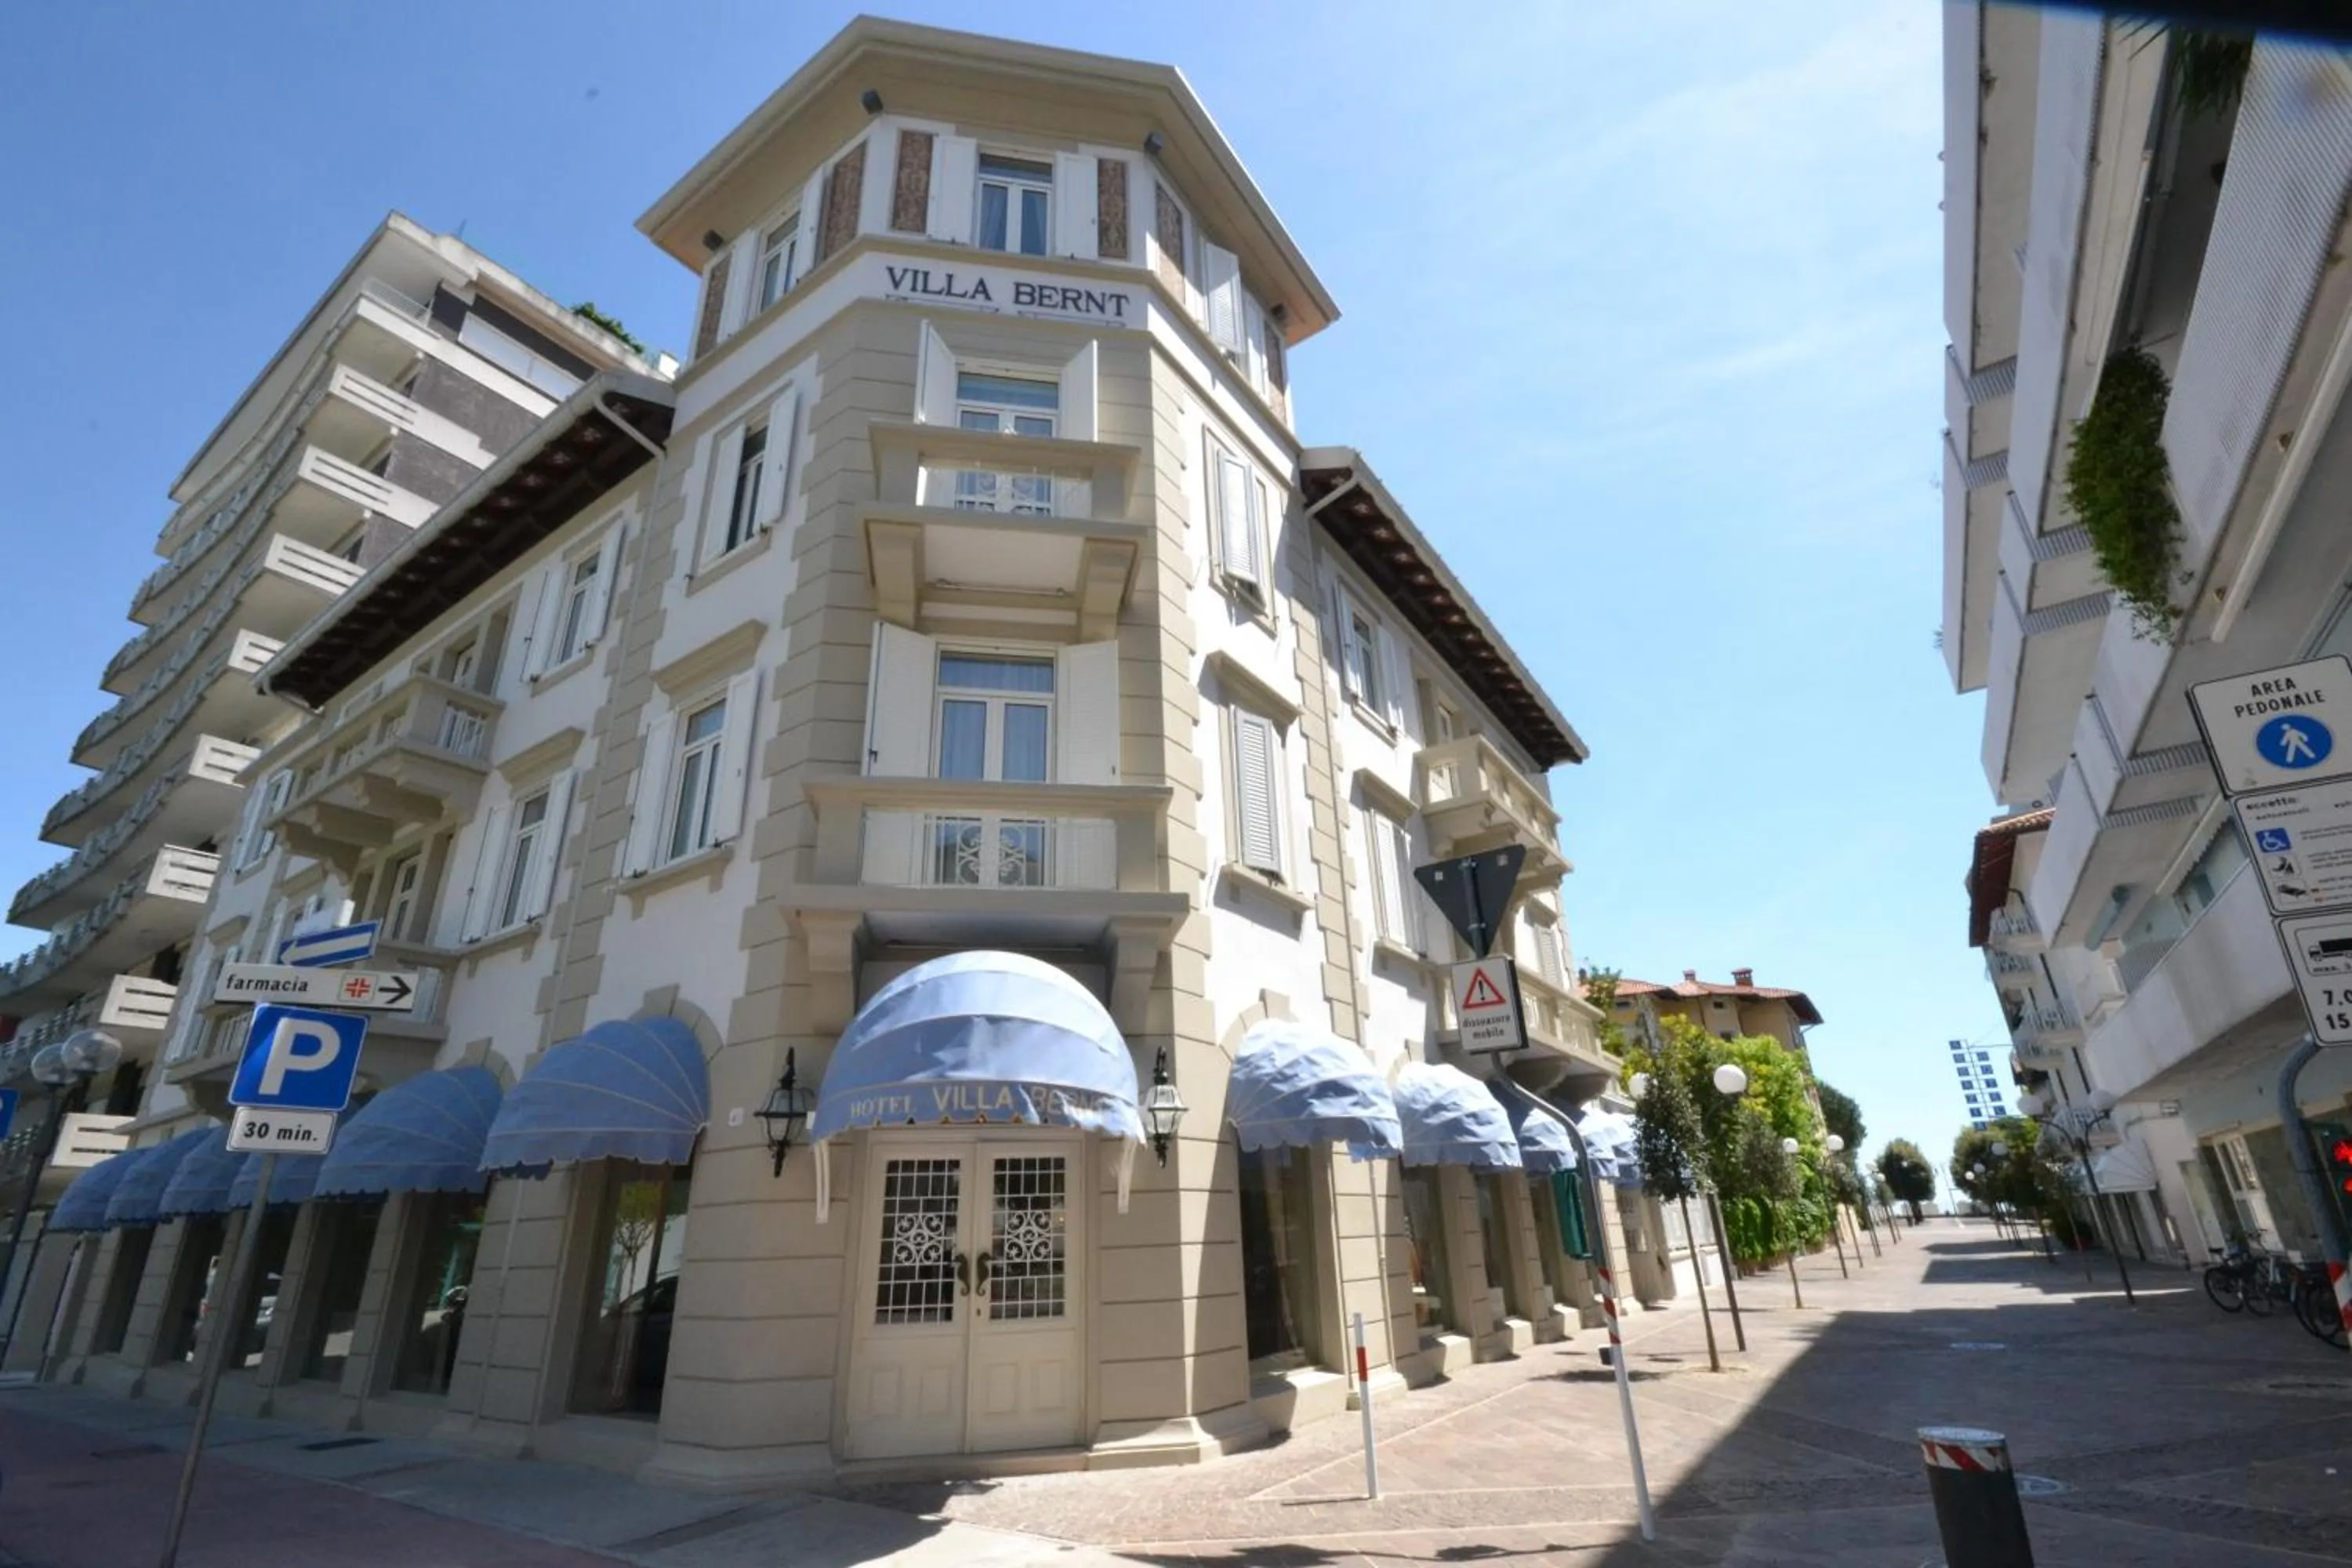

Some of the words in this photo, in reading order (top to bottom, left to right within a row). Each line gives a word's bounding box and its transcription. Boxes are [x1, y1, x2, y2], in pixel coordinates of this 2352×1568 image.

[886, 266, 992, 301] VILLA
[1013, 281, 1130, 317] BERNT
[2250, 677, 2296, 698] AREA
[2234, 689, 2326, 718] PEDONALE
[226, 974, 309, 993] farmacia
[2326, 1013, 2350, 1029] 15
[258, 1017, 341, 1095] P
[850, 1095, 913, 1118] HOTEL
[931, 1085, 1014, 1111] VILLA
[243, 1122, 270, 1138] 30
[277, 1124, 318, 1142] min.
